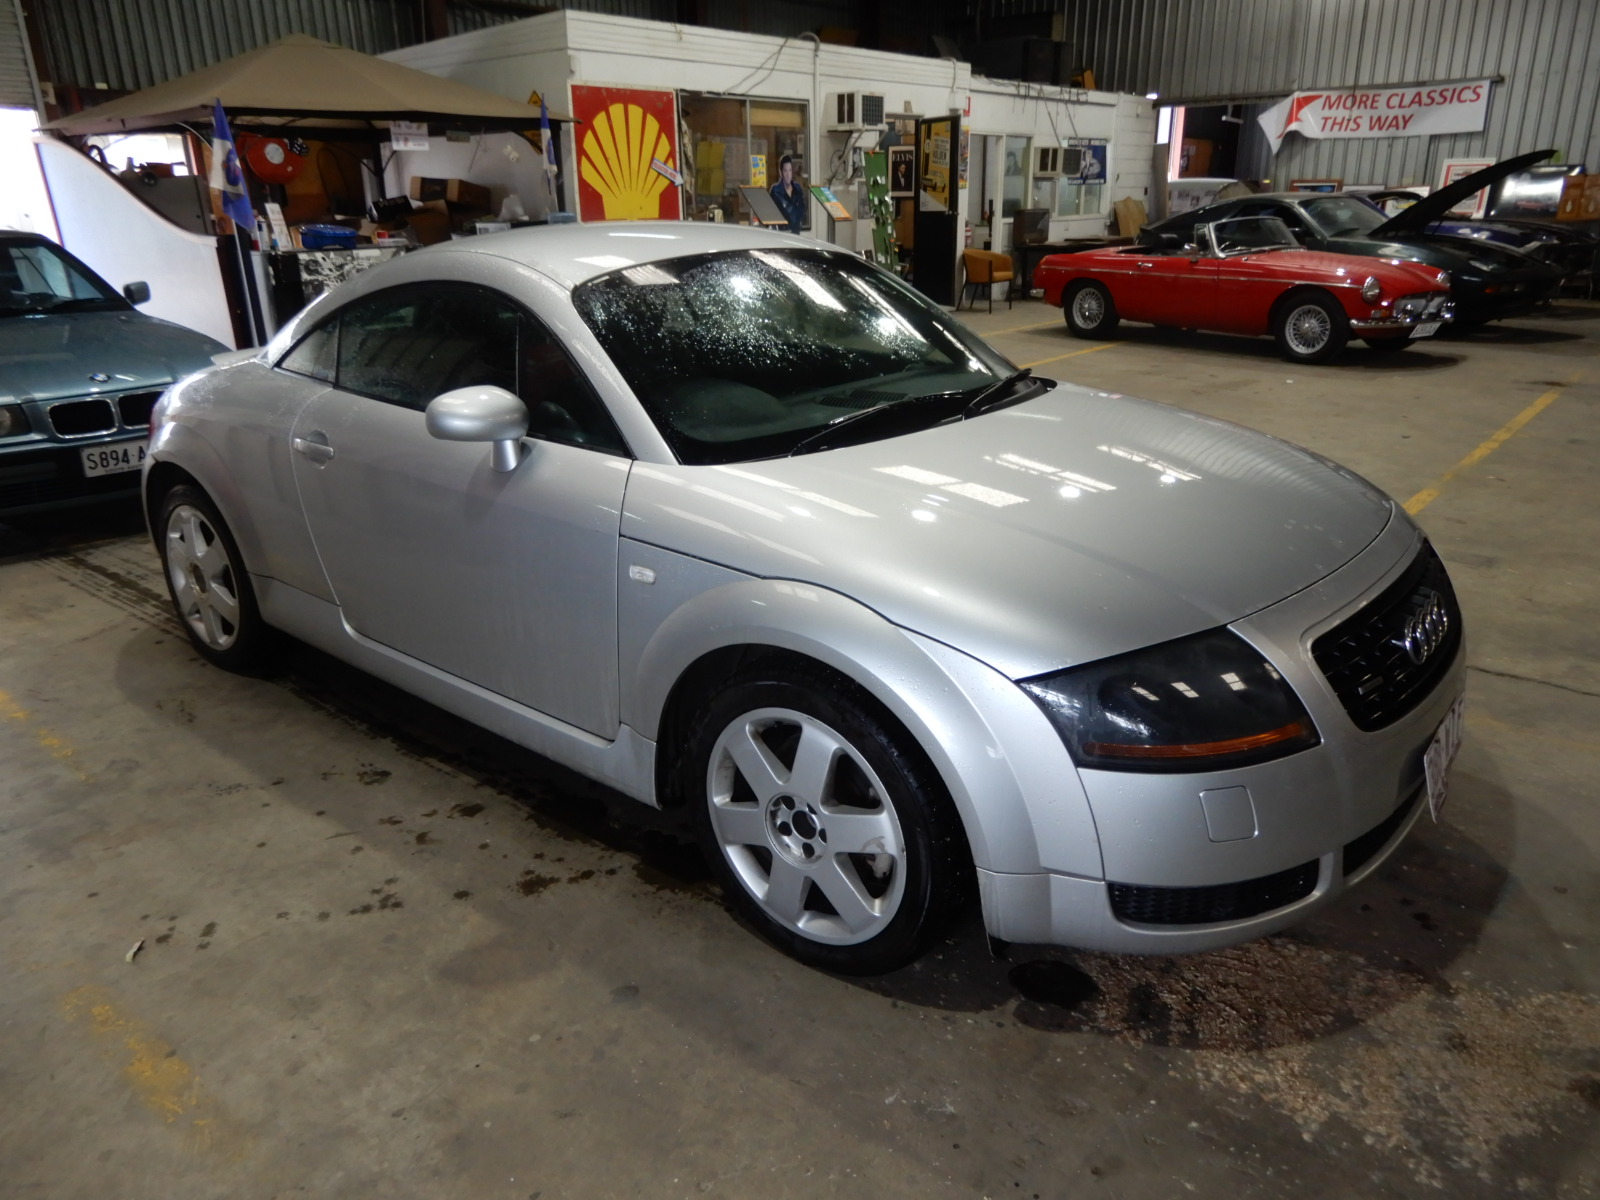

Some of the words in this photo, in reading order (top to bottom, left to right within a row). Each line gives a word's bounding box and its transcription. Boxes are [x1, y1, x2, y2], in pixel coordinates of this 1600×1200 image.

[1321, 93, 1380, 111] MORE
[1385, 84, 1483, 109] CLASSICS
[1320, 116, 1361, 133] THIS
[1368, 113, 1414, 132] WAY
[892, 153, 913, 162] ELVIS
